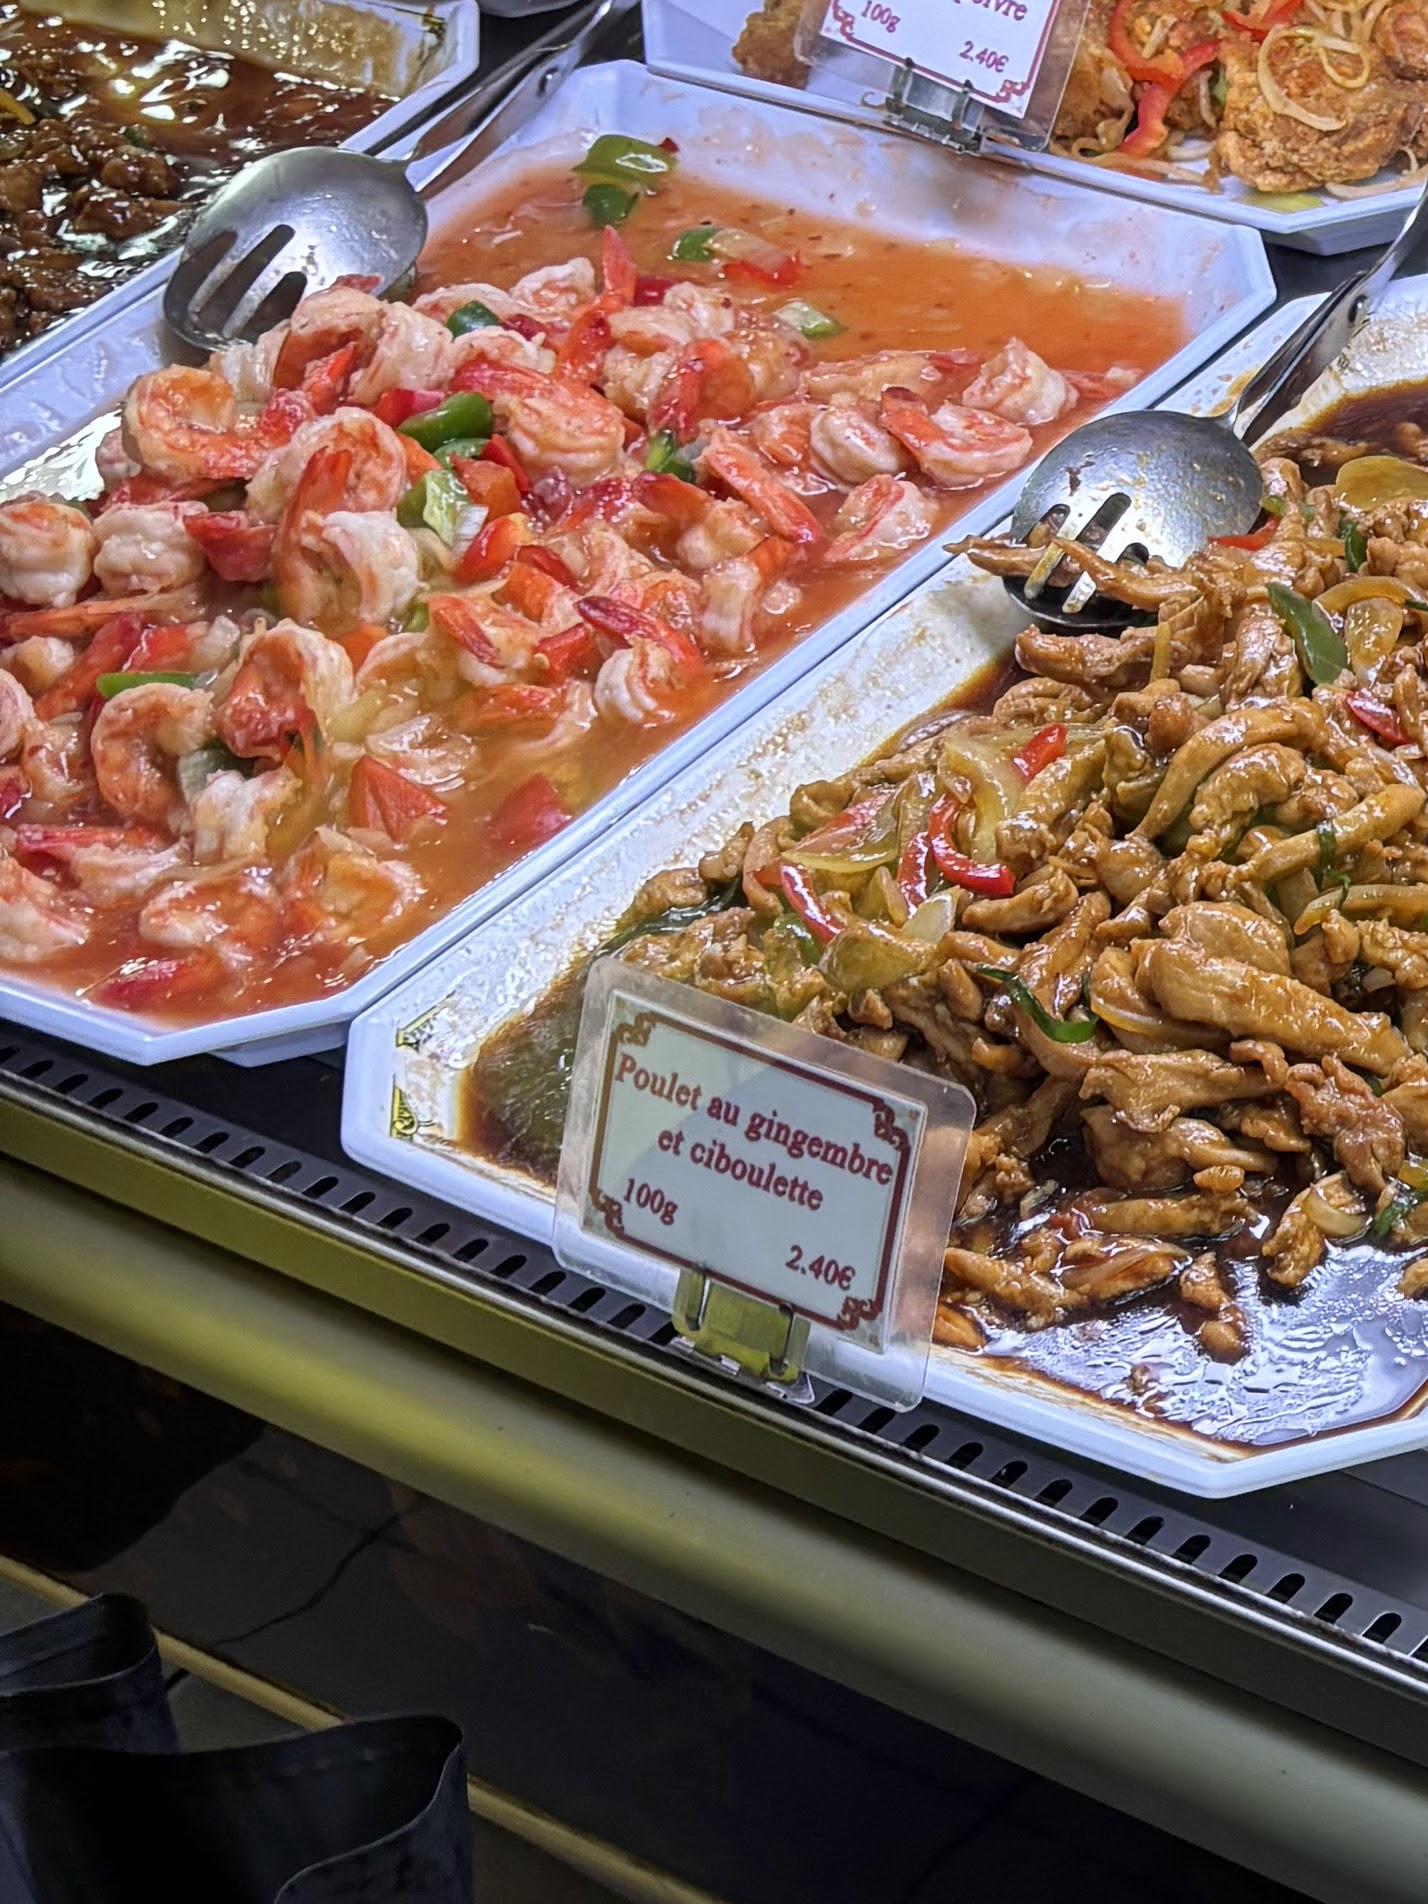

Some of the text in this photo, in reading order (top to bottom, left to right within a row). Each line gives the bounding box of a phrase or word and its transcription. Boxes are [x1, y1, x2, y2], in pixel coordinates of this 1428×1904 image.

[861, 0, 1009, 73] 100g 2.40€
[614, 1053, 894, 1186] Poulet au gingembre
[657, 1127, 824, 1212] et ciboulette
[622, 1178, 857, 1291] 100g 2.40€
